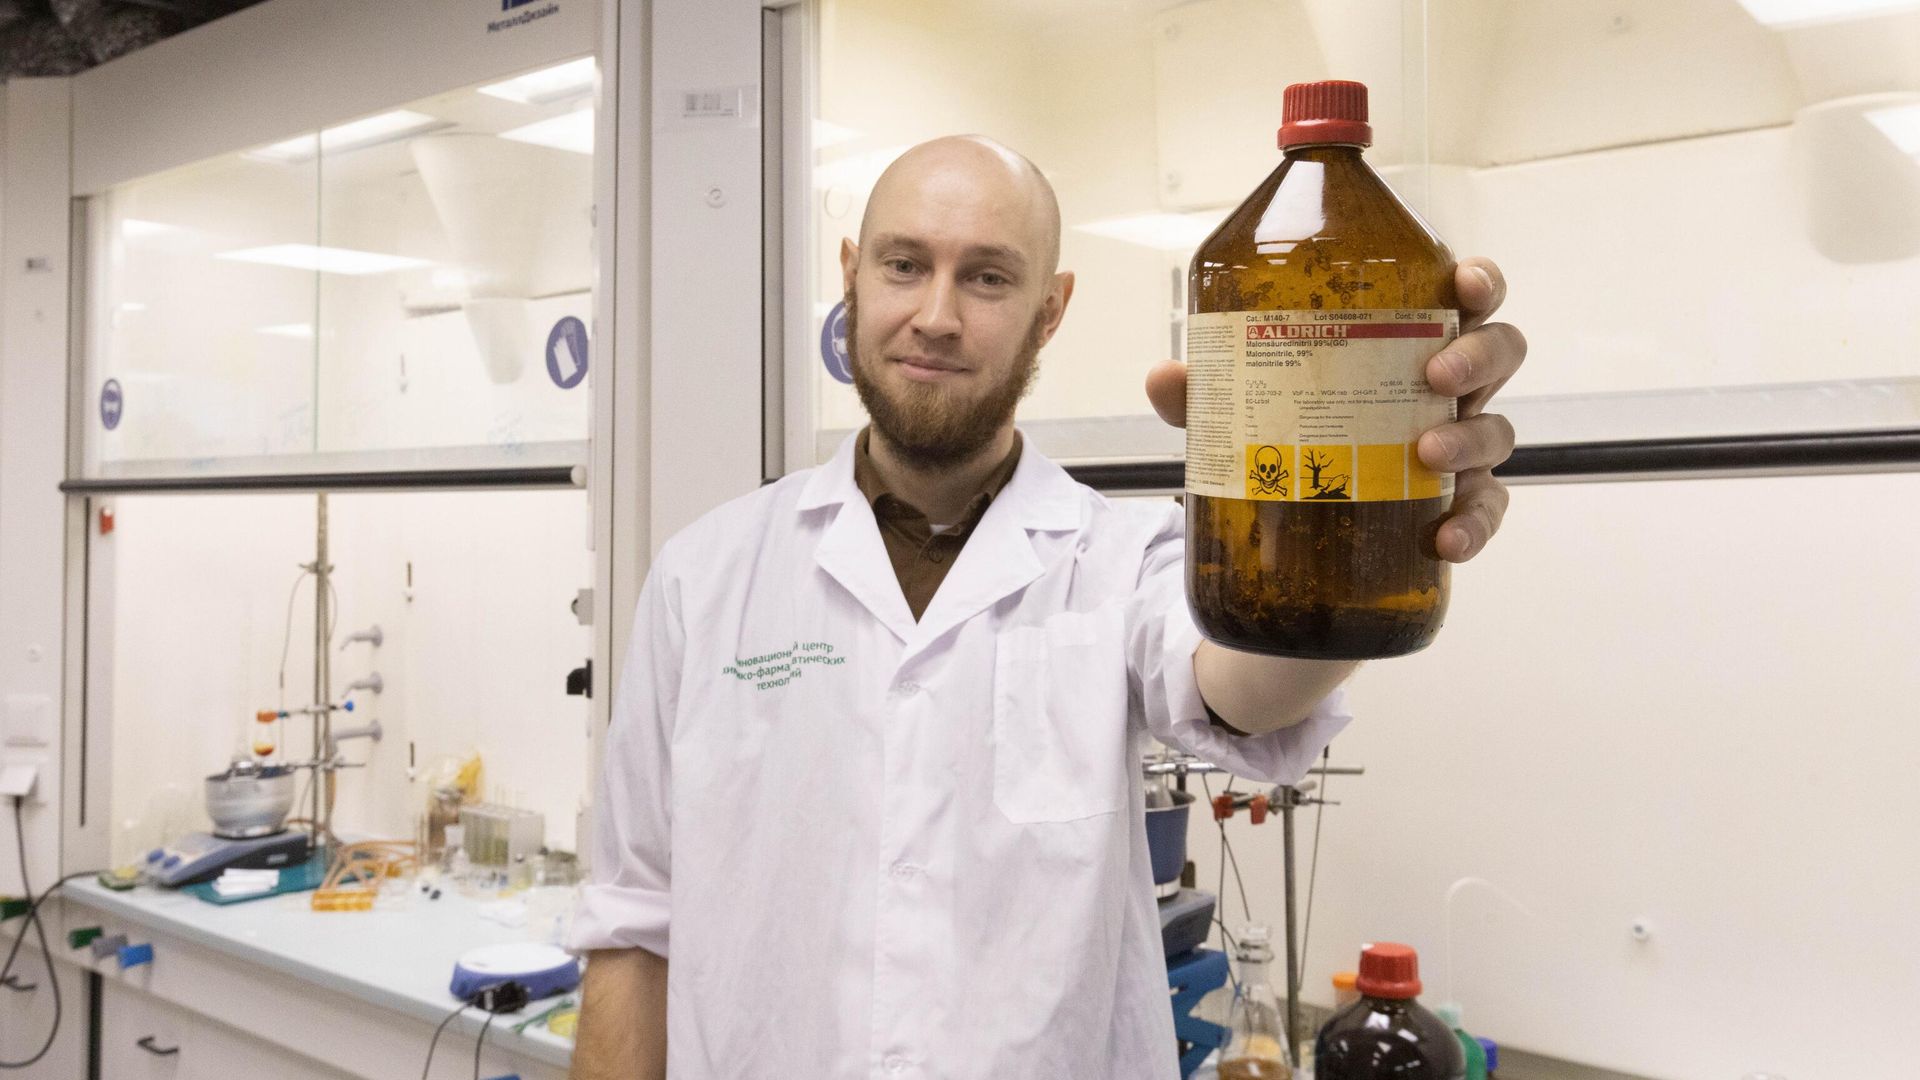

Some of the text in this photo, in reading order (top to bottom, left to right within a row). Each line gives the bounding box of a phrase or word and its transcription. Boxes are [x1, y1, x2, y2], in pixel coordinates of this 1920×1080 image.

[1263, 314, 1290, 322] M140-7
[1314, 313, 1327, 321] Lot
[1261, 325, 1347, 339] ALDRICH
[1246, 350, 1295, 358] Malononitrile,
[1246, 359, 1302, 367] malonitrile 99%
[802, 641, 834, 654] центр
